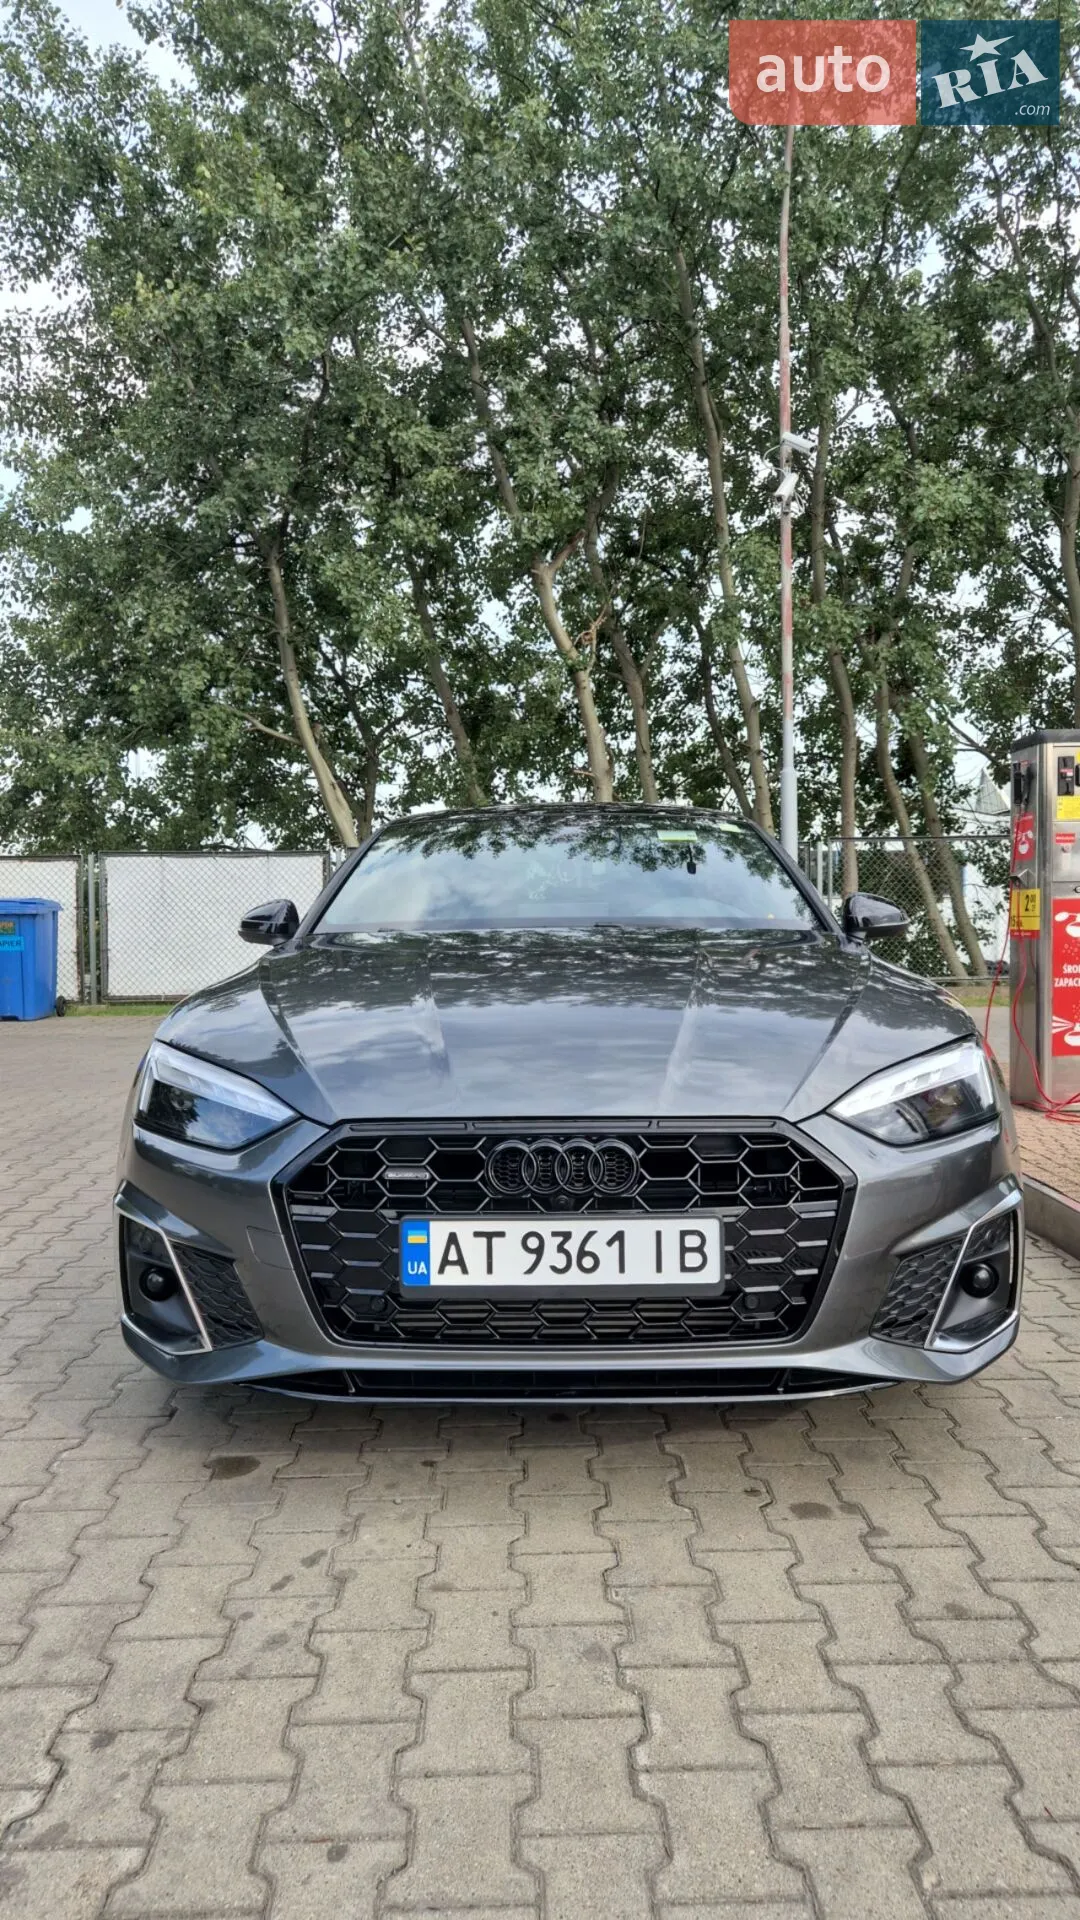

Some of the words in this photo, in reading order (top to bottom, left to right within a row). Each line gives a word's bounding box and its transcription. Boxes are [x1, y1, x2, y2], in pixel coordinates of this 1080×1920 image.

[437, 1231, 506, 1275] AT
[520, 1230, 625, 1275] 9361
[655, 1229, 708, 1274] IB
[407, 1261, 428, 1275] UA
